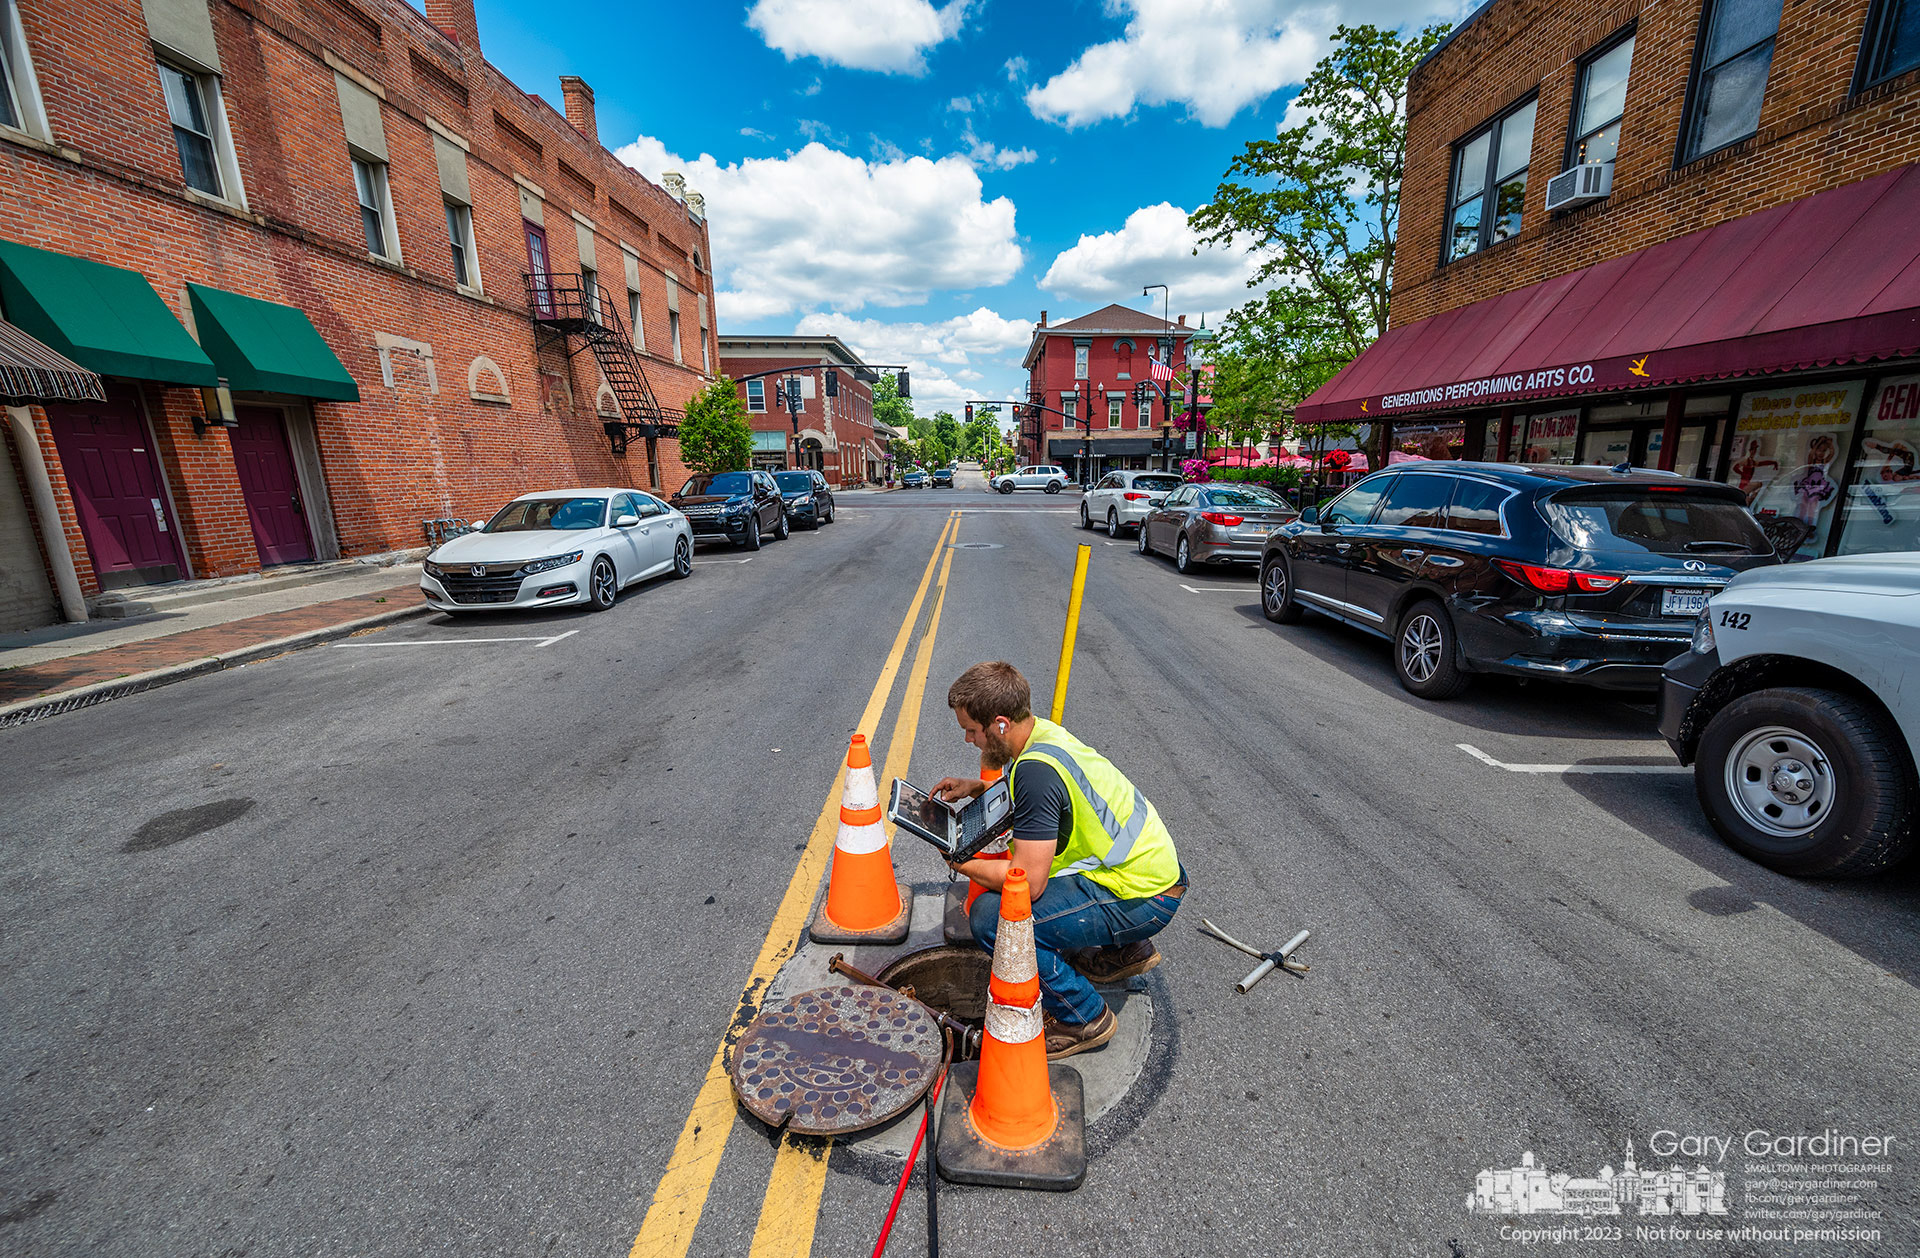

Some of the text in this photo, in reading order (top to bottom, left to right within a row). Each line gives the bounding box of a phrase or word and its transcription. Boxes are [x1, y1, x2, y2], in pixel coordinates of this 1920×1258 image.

[1381, 364, 1595, 409] GENERATIONS PERFORMING ARTS CO.
[1752, 389, 1848, 411] Where every
[1878, 382, 1920, 421] GEN
[1737, 410, 1850, 432] student counts
[1861, 479, 1894, 525] Tumbling
[1666, 595, 1683, 609] JFY
[1719, 610, 1752, 631] 142
